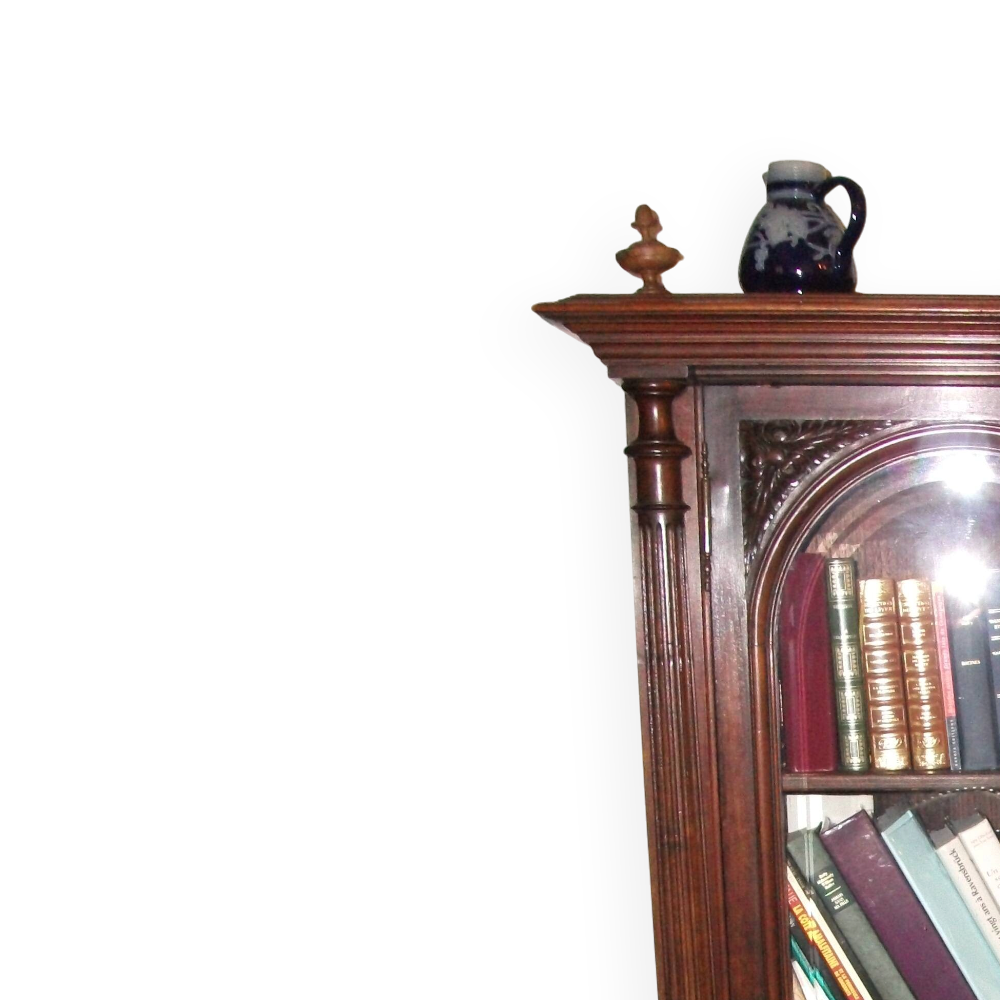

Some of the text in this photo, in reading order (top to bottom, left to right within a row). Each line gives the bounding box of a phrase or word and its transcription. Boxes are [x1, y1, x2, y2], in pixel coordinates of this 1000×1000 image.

[947, 847, 979, 896] Ravensbrück
[792, 905, 804, 916] LA
[979, 902, 990, 916] ans
